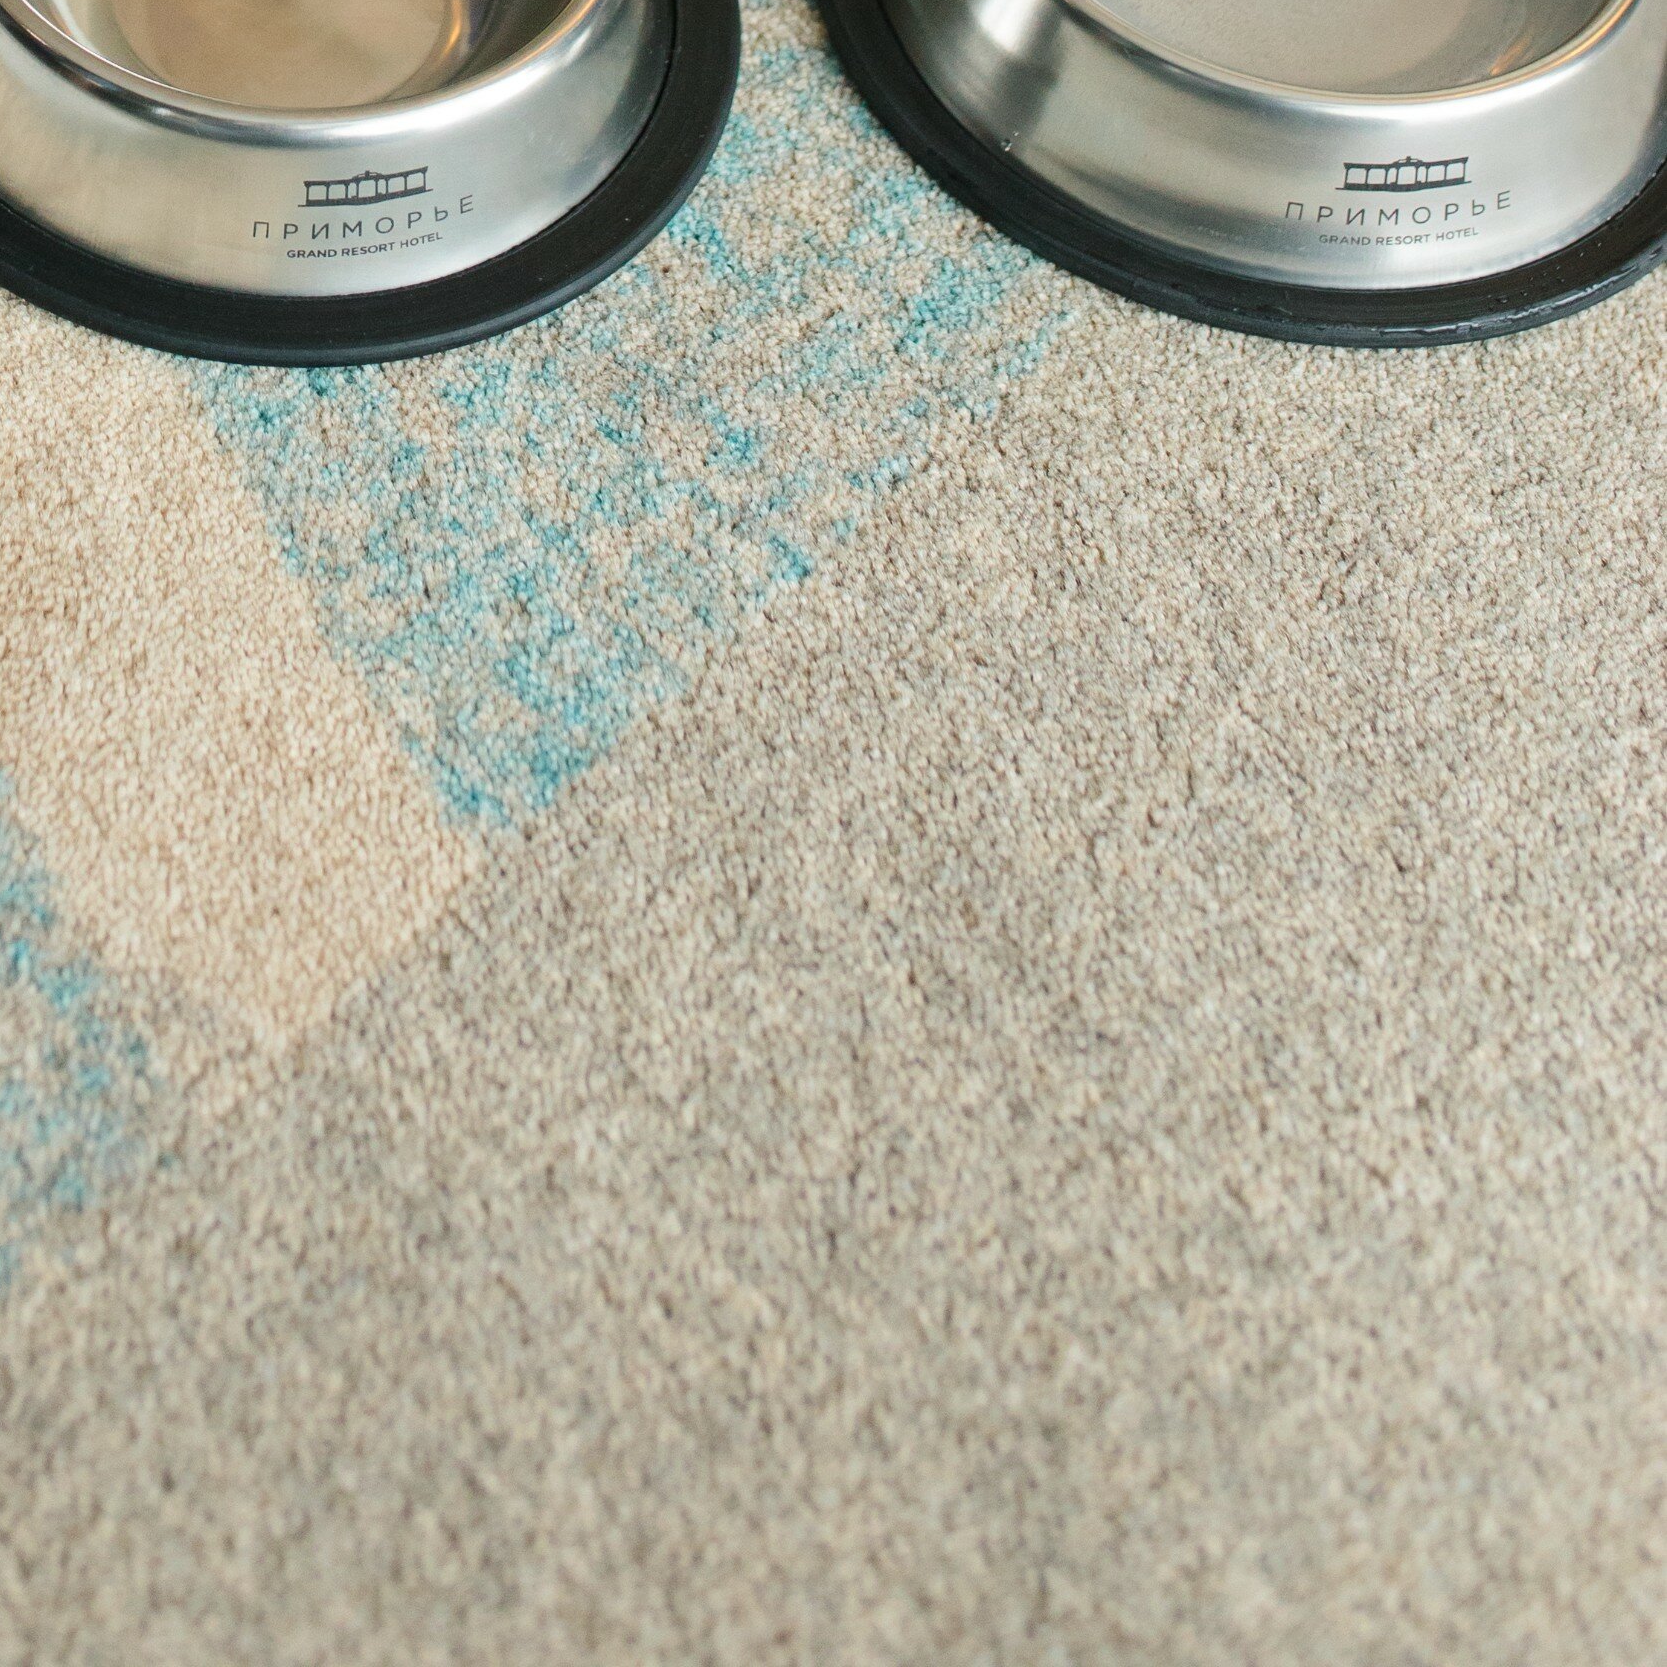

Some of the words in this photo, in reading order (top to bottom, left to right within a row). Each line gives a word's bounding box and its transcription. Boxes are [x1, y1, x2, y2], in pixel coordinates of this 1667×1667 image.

[252, 194, 474, 240] ПРИМОРЬЕ
[1284, 189, 1512, 227] ПРИМОРЬЕ
[286, 248, 338, 259] GRAND
[341, 241, 396, 257] RESORT
[400, 231, 444, 250] HOTEL
[1318, 233, 1371, 246] GRAND
[1375, 233, 1431, 246] RESORT
[1435, 227, 1480, 243] HOTEL
